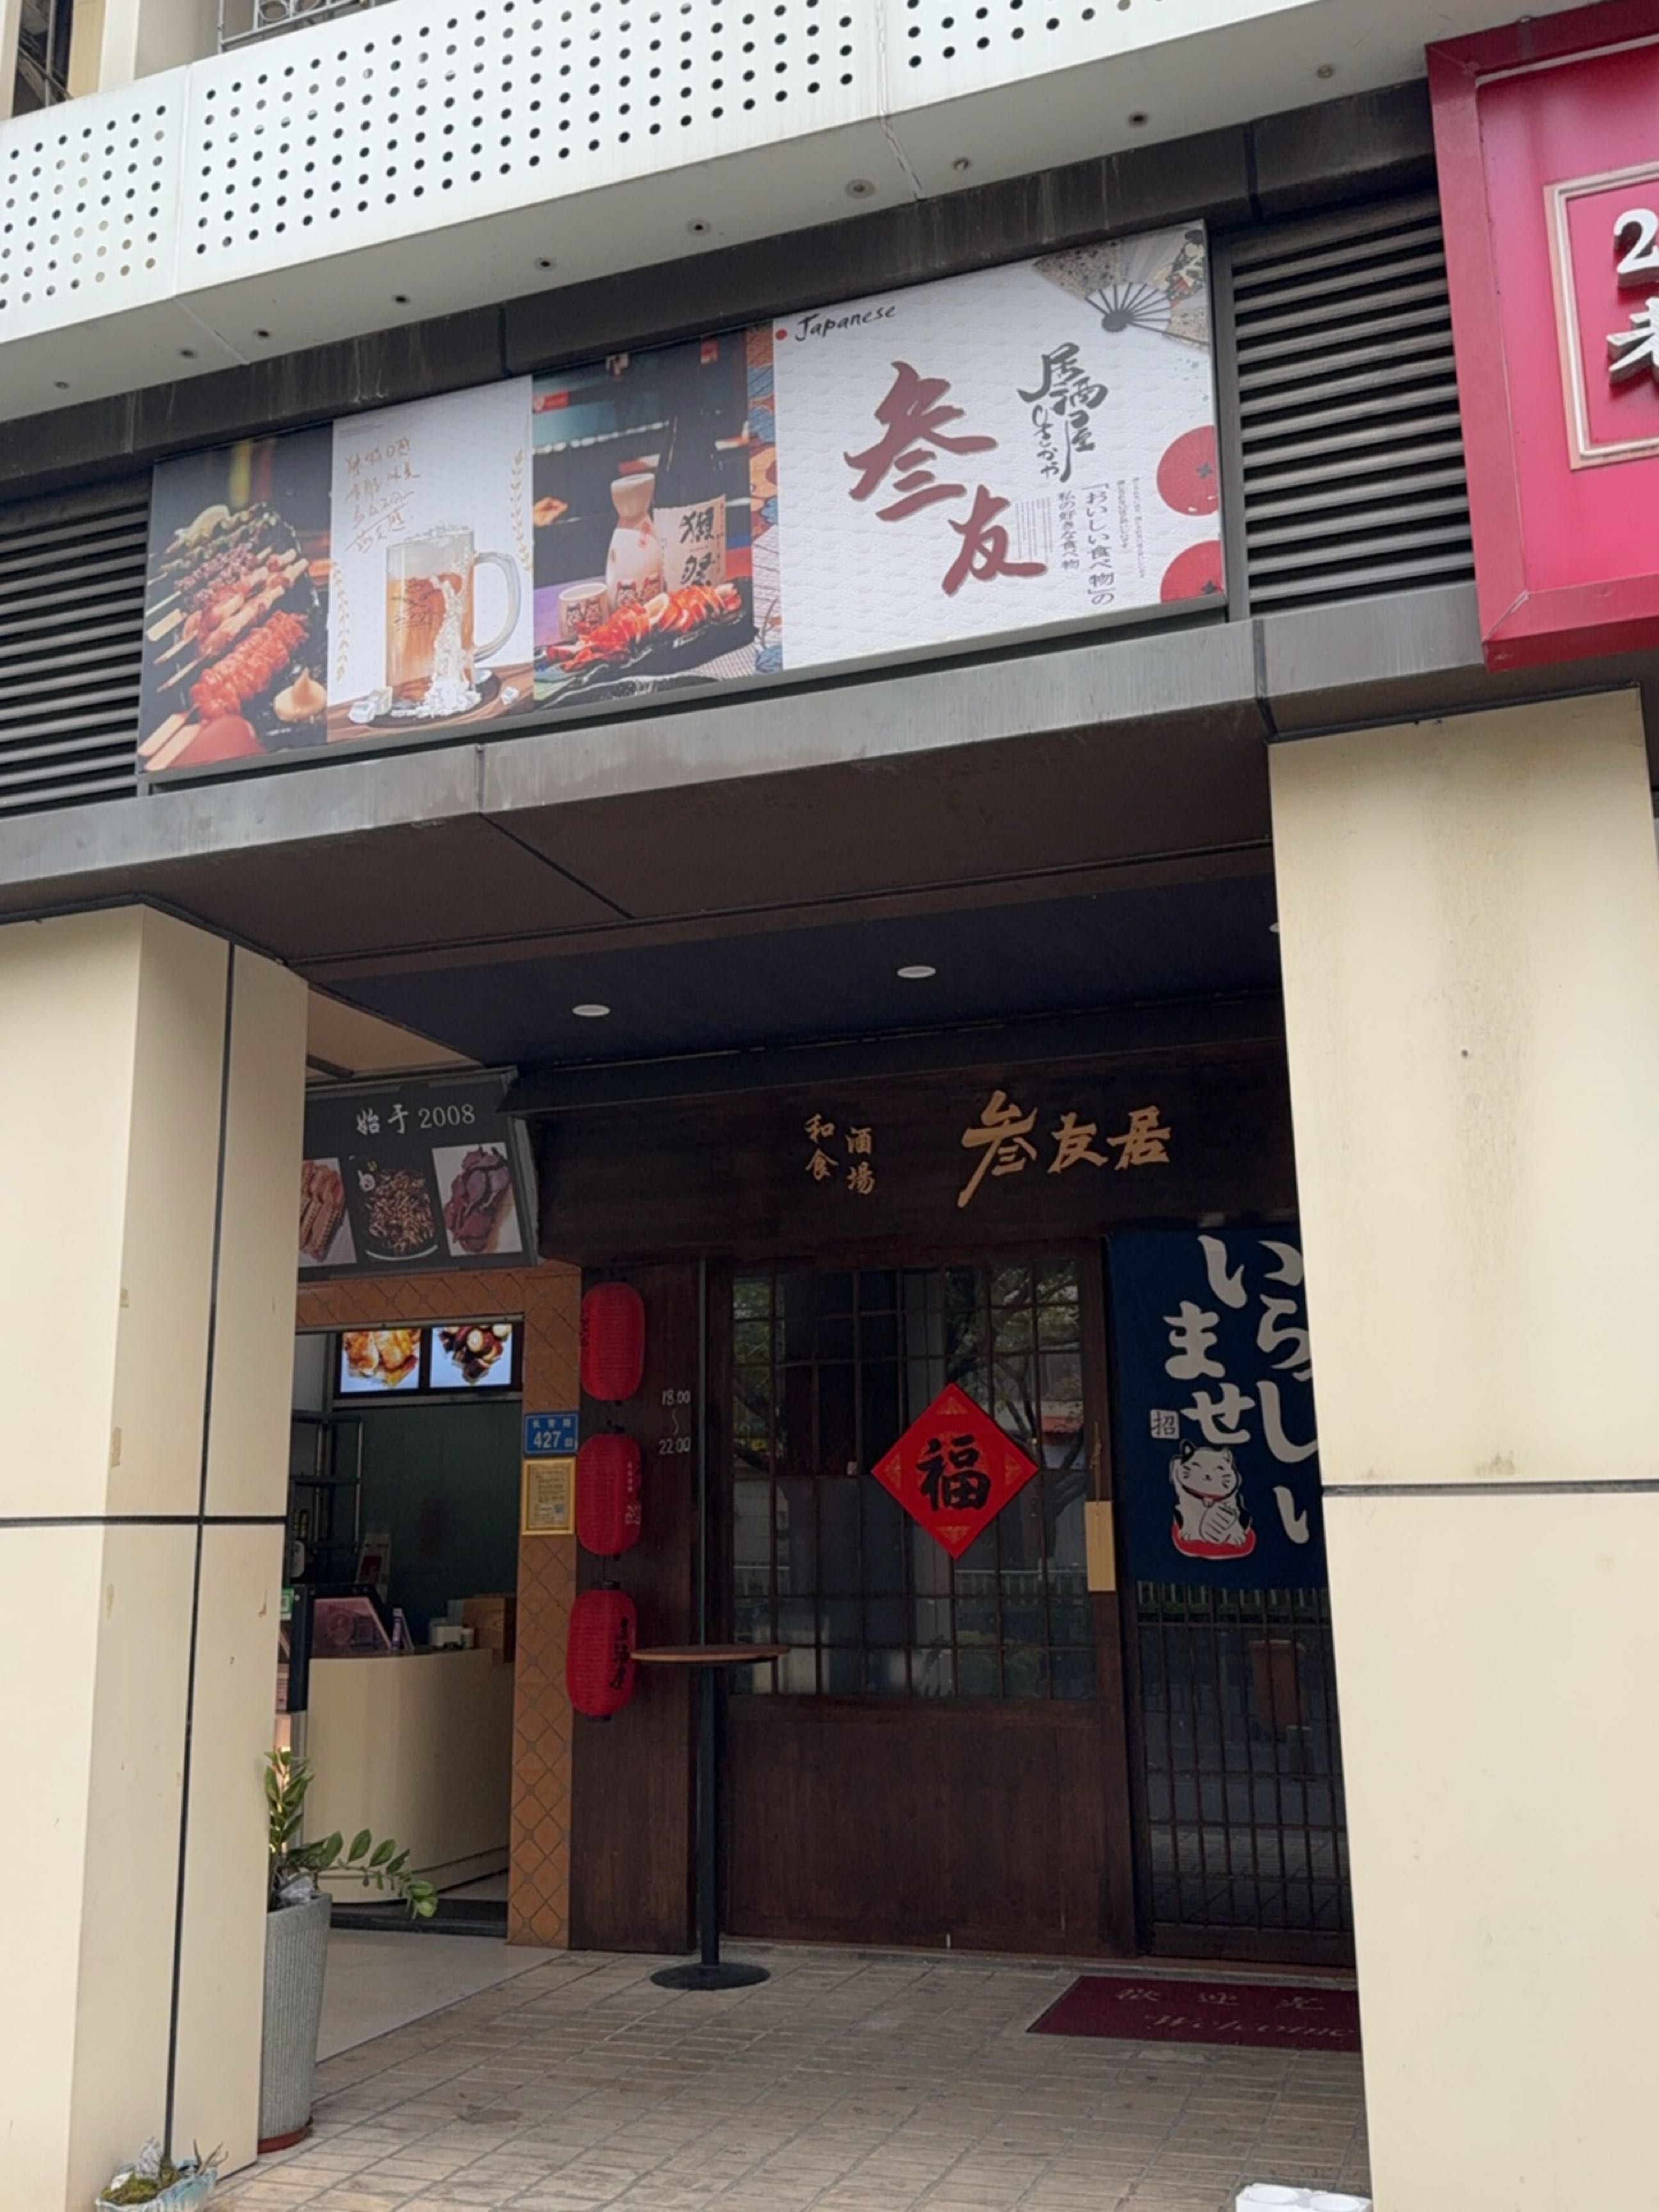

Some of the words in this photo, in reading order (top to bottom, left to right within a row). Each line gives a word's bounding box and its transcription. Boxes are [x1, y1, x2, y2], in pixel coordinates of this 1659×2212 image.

[795, 305, 896, 342] Japanese
[356, 1103, 410, 1135] 始于
[419, 1104, 476, 1129] 2008
[1153, 1412, 1176, 1436] 招
[915, 1434, 991, 1511] 福
